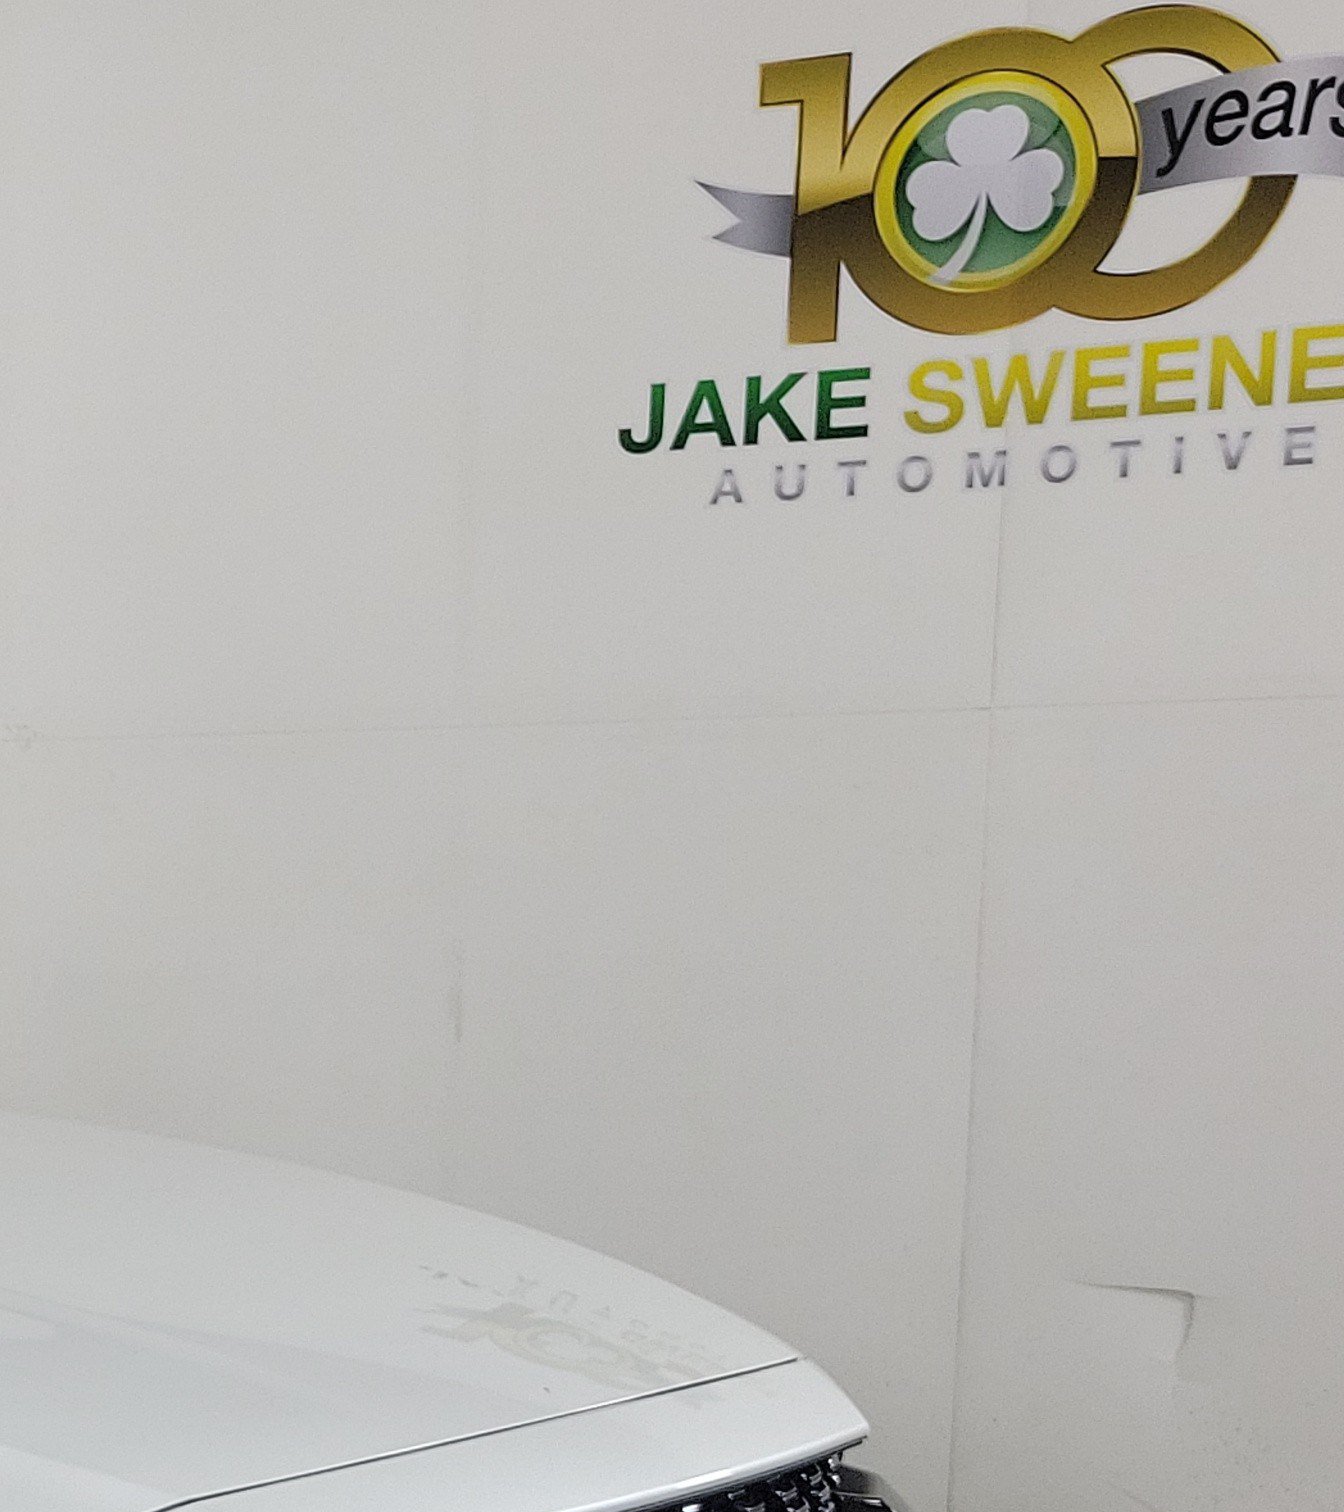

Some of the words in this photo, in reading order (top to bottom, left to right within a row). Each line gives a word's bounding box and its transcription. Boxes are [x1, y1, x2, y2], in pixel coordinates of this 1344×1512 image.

[759, 4, 1298, 345] 100
[618, 367, 871, 455] JAKE
[710, 425, 1315, 505] AUTOMOTIVE
